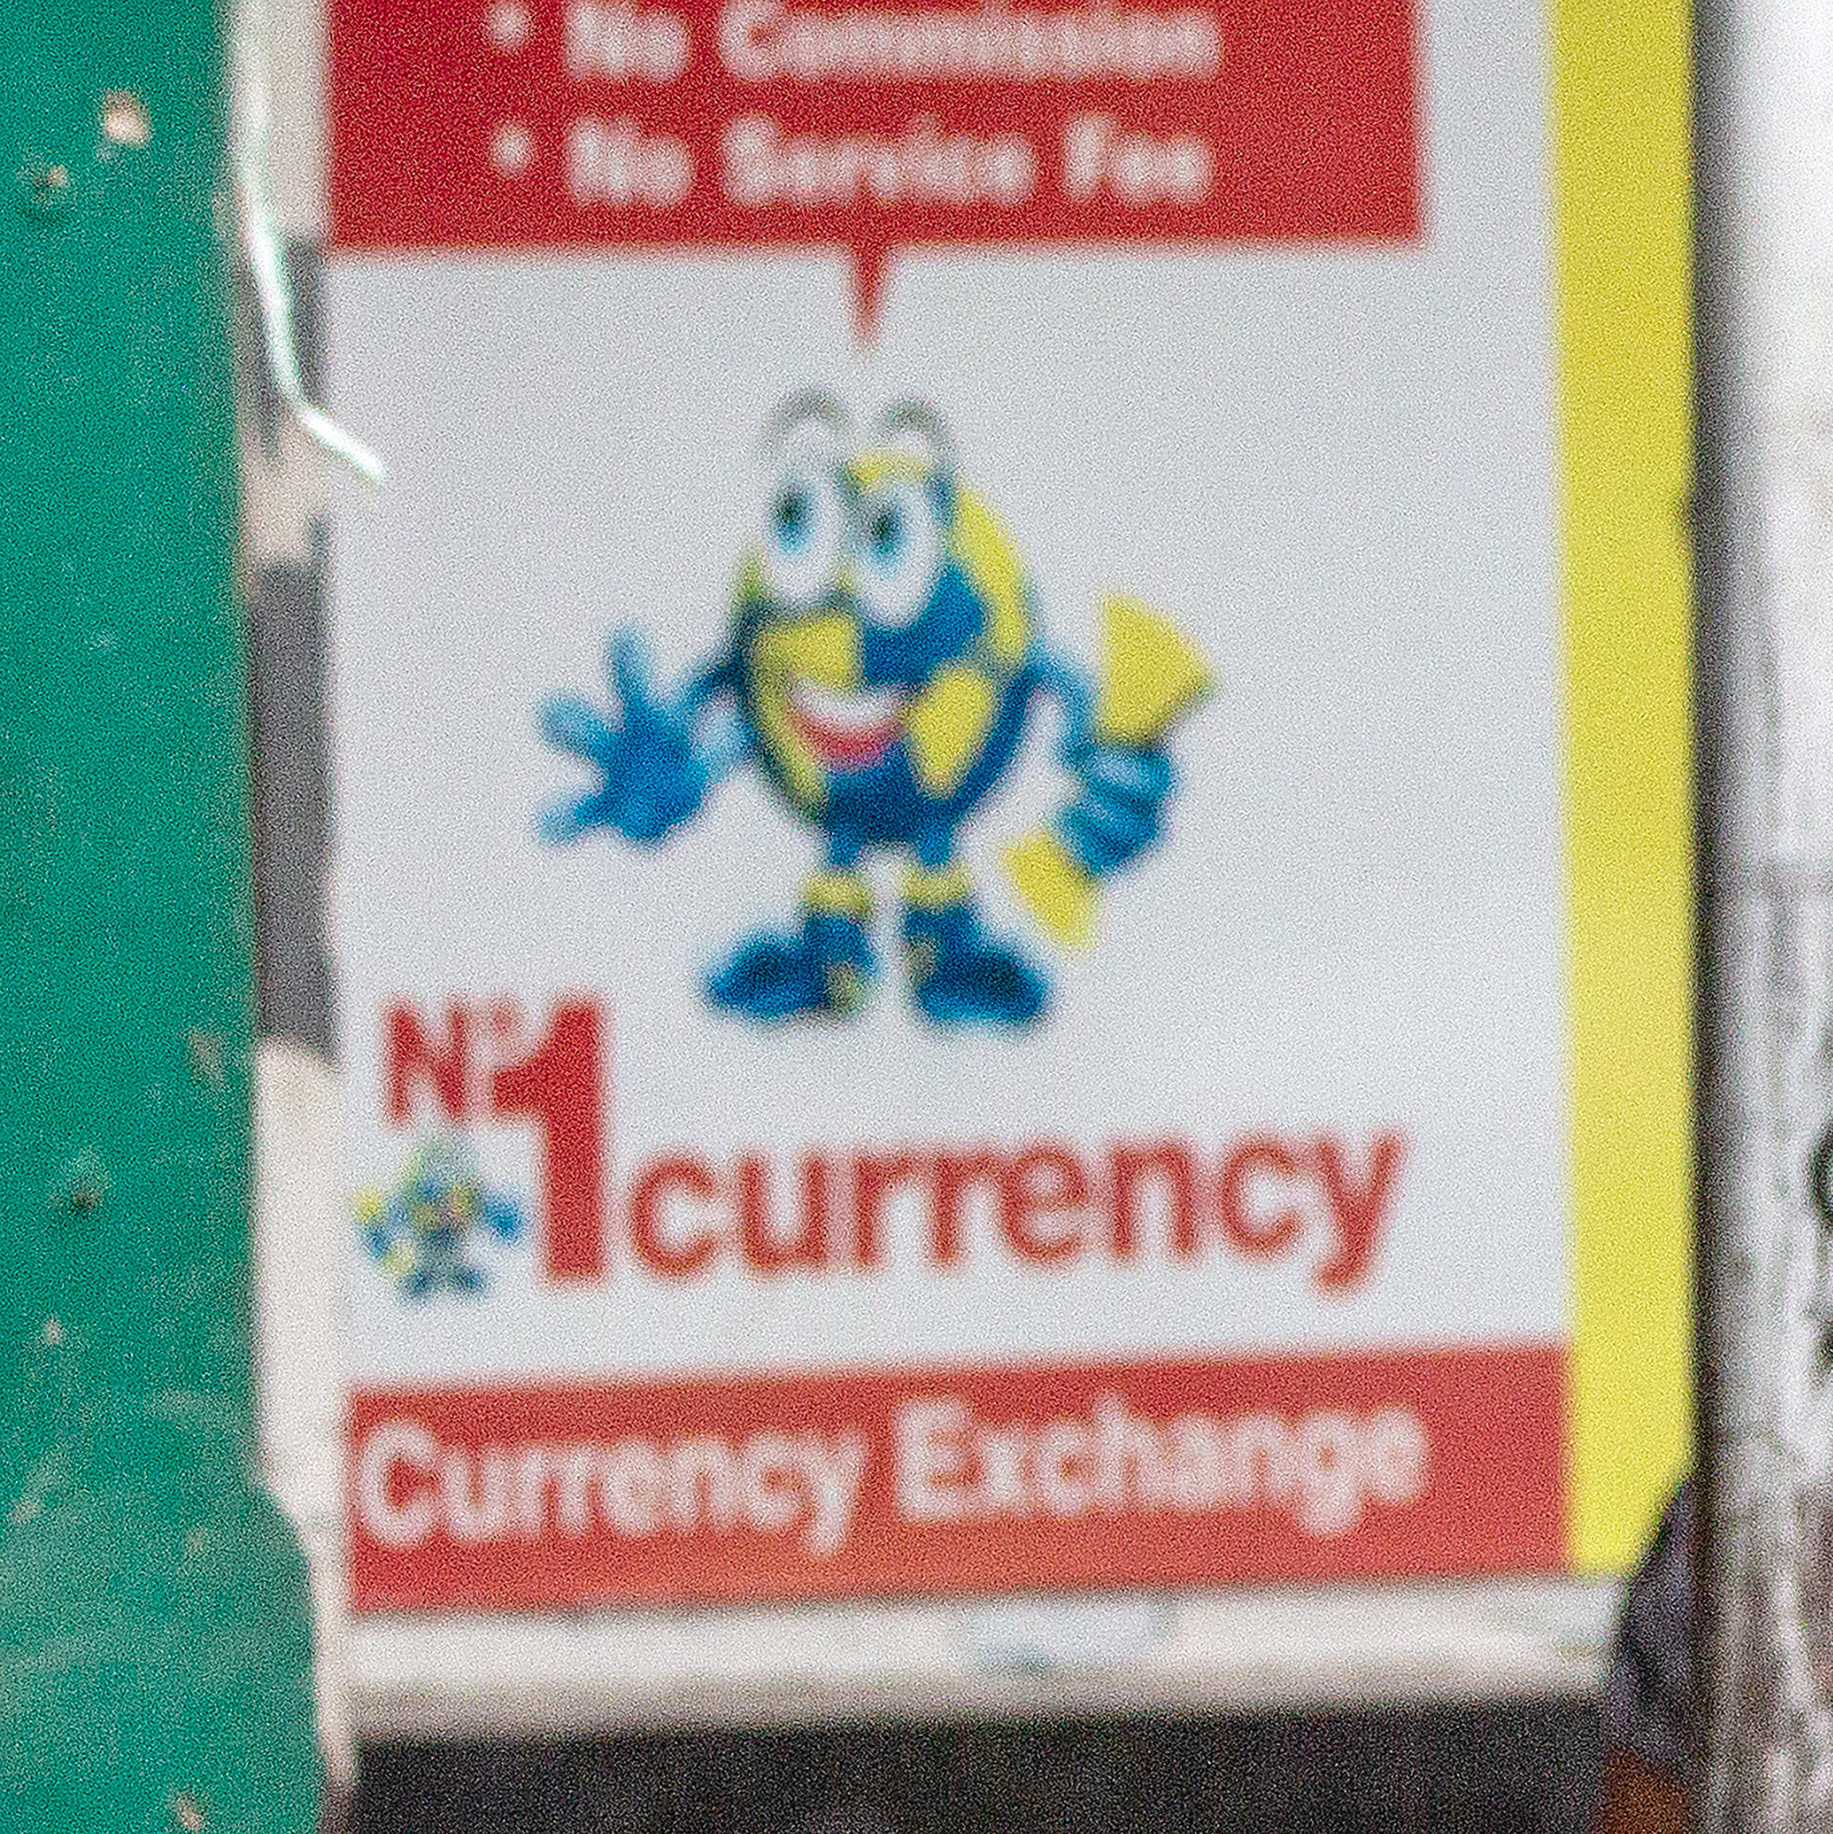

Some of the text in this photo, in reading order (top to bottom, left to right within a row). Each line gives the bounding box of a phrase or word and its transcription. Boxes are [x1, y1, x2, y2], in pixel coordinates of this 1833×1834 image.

[565, 112, 1214, 206] No Service Fee
[626, 1122, 1407, 1292] currency
[357, 1396, 1430, 1558] Currency Exchange
